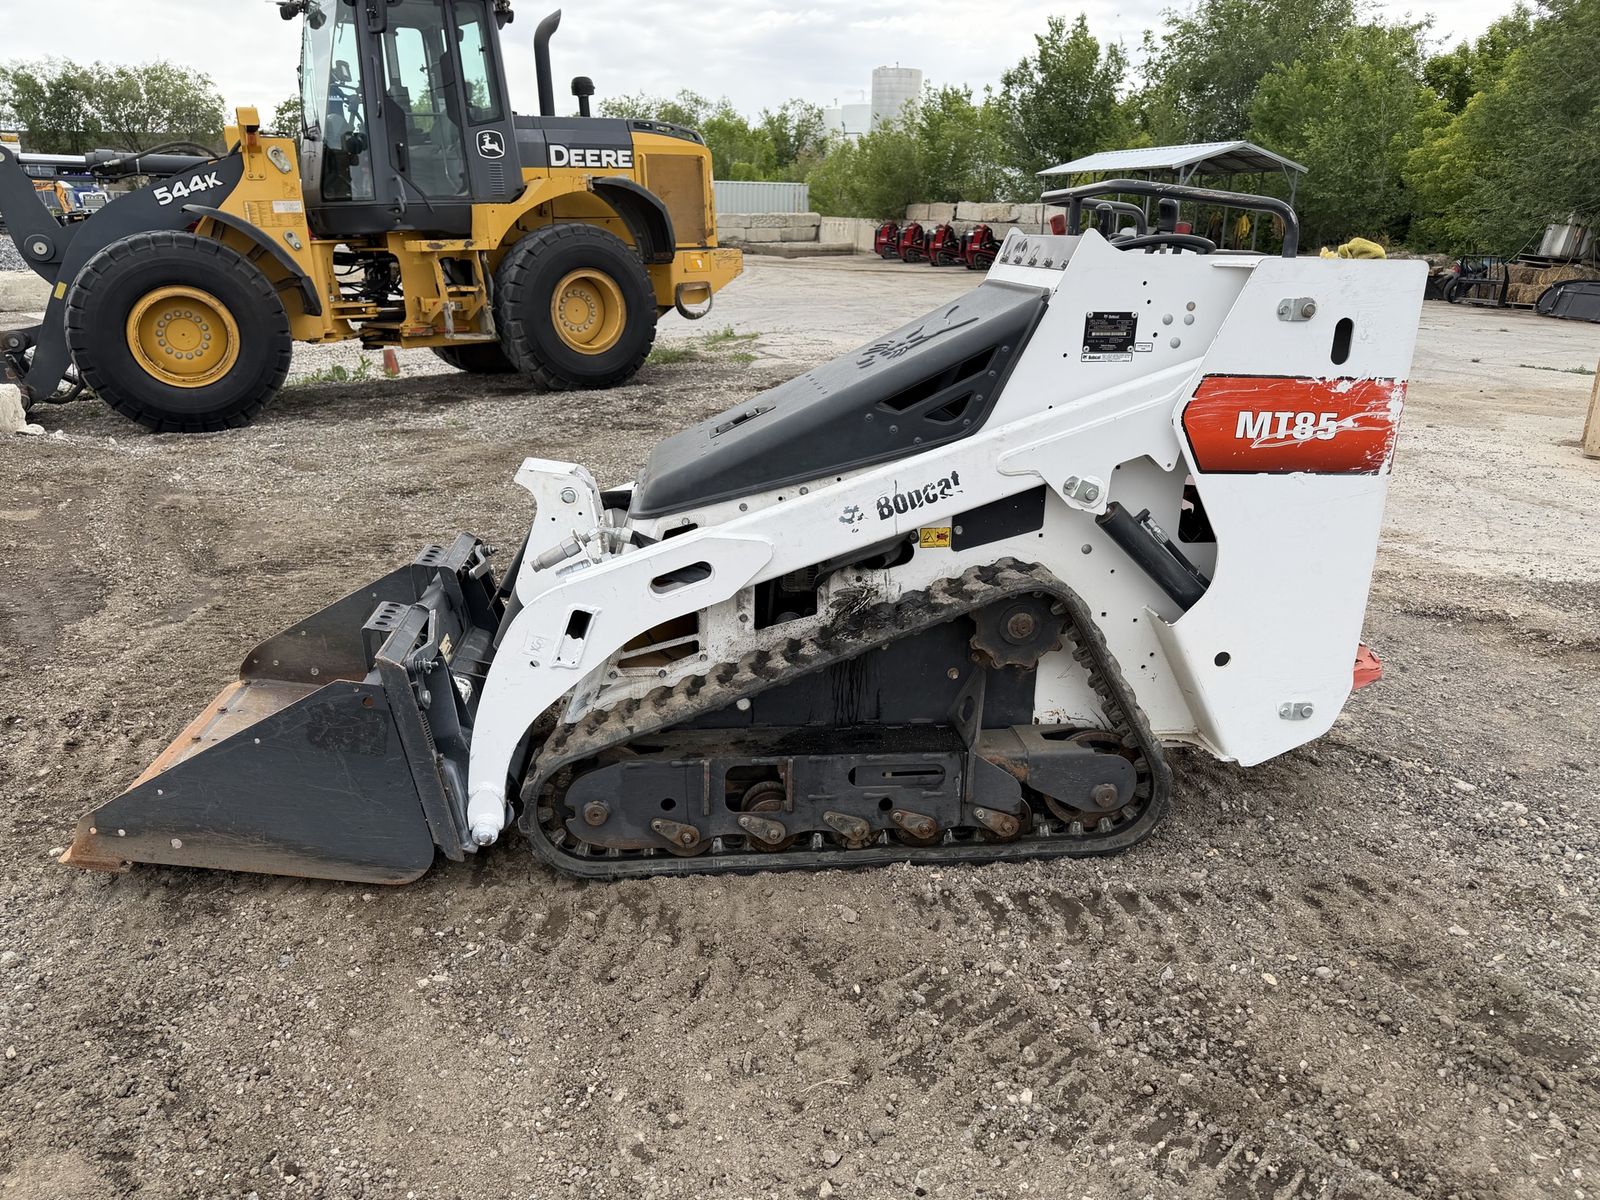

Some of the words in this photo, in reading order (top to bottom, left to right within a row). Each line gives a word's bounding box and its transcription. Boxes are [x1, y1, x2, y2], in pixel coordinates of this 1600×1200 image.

[549, 144, 632, 168] DEERE
[153, 171, 224, 206] 544K
[1234, 411, 1339, 441] MT85
